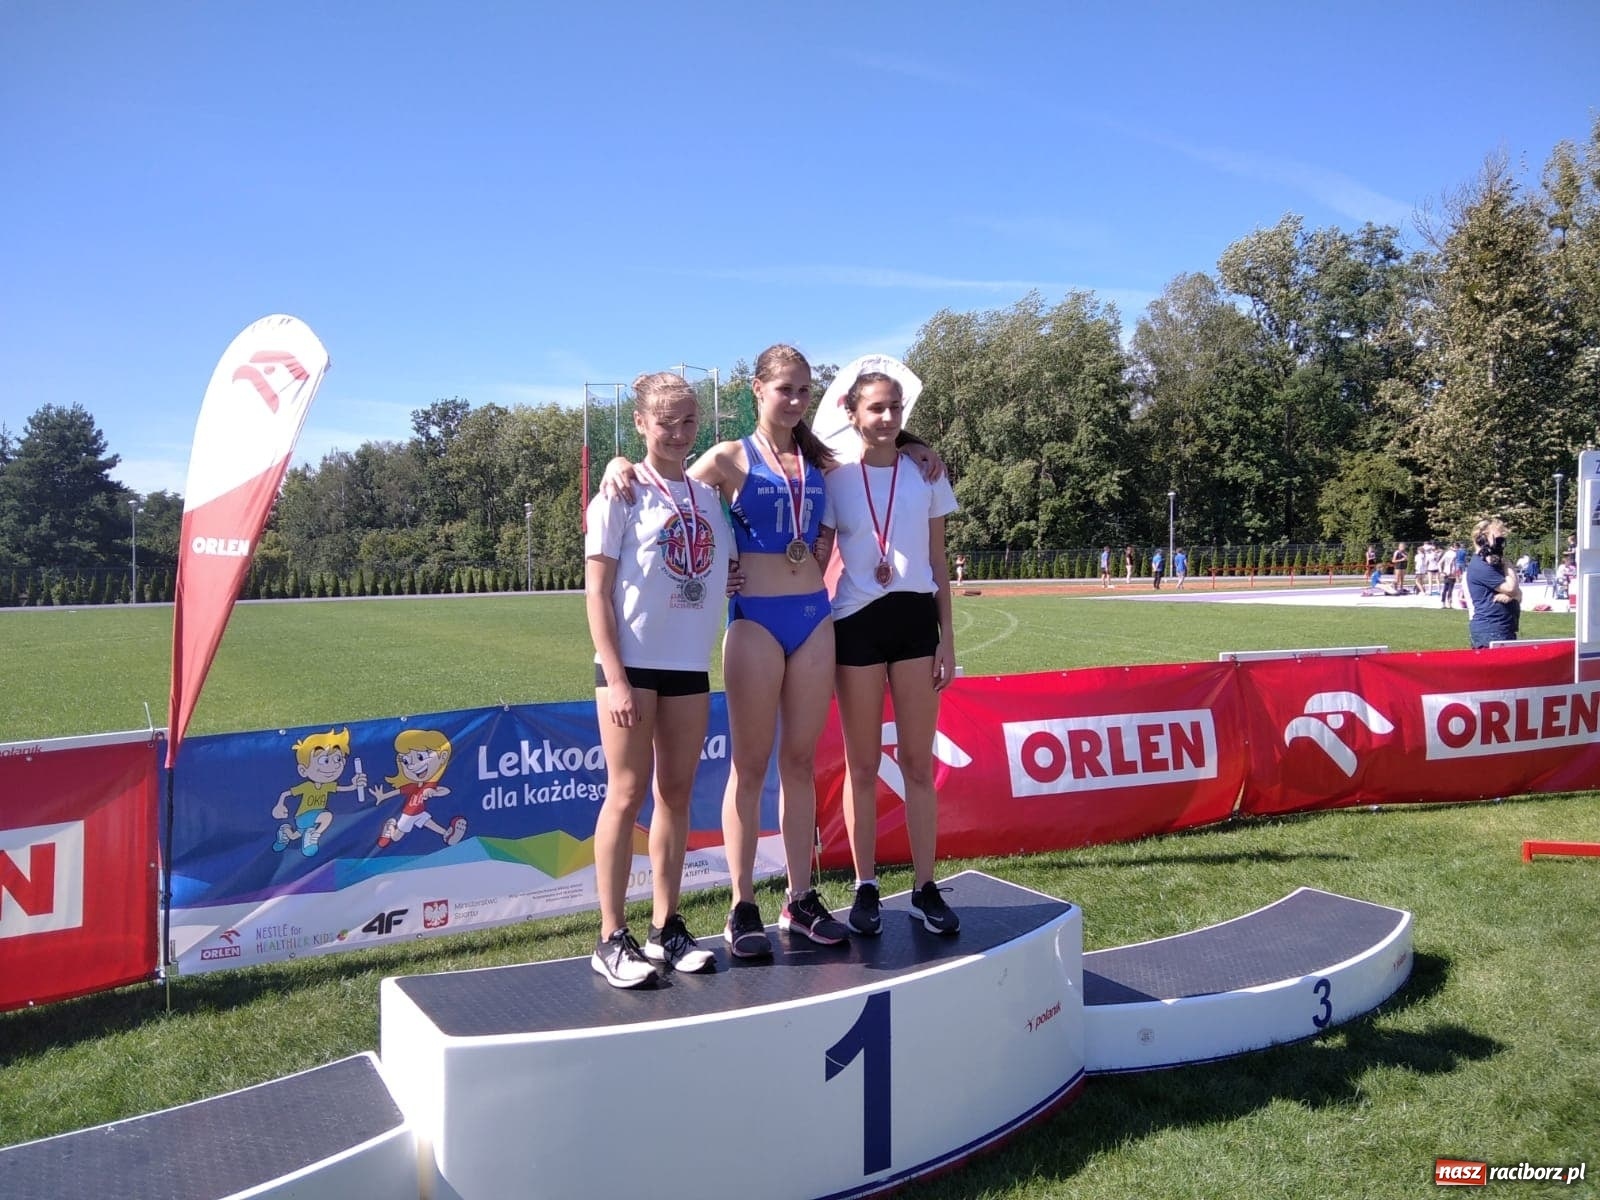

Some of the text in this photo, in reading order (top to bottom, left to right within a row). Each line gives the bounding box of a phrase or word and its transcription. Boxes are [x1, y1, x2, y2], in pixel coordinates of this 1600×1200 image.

[191, 537, 250, 556] ORLEN
[1436, 690, 1600, 749] ORLEN
[1020, 720, 1206, 784] ORLEN
[482, 778, 607, 810] dla każdego
[291, 926, 302, 936] for
[361, 908, 409, 935] 4F
[202, 947, 240, 959] ORLEN
[1312, 978, 1332, 1028] 3
[825, 990, 892, 1176] 1
